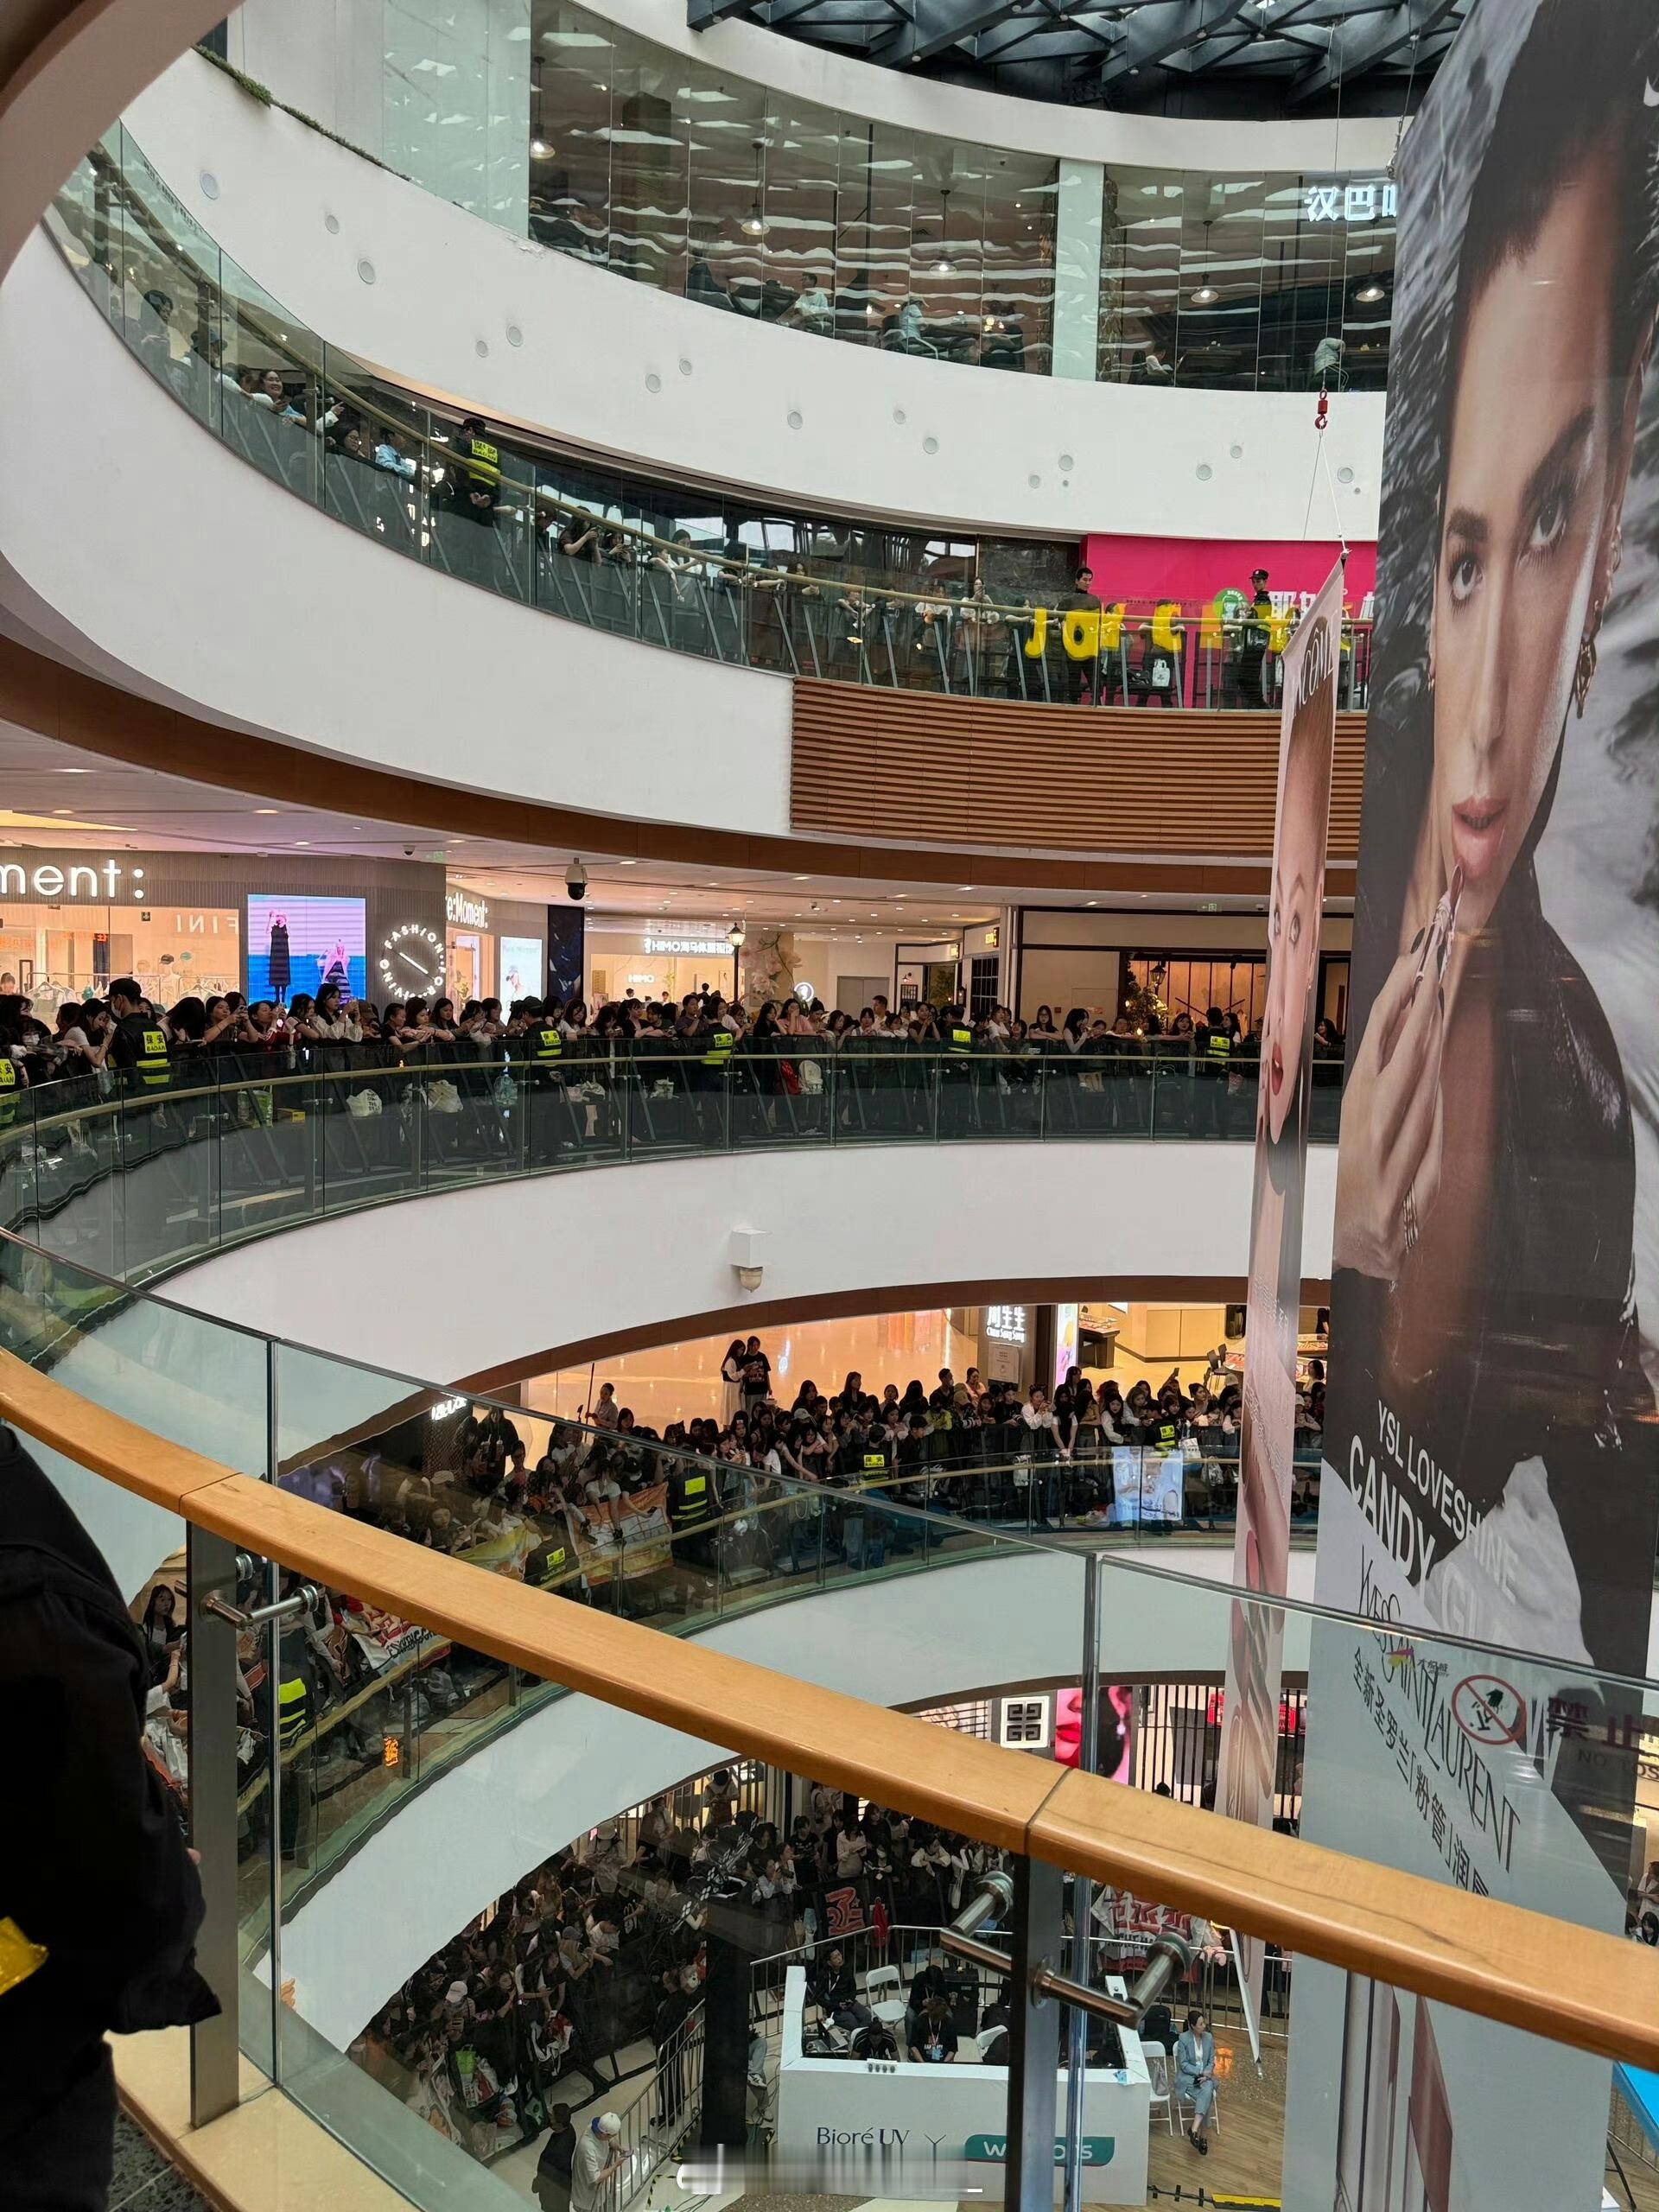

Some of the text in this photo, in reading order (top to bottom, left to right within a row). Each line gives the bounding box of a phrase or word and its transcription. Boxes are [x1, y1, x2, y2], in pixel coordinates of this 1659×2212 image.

[445, 892, 489, 929] e:Moment:
[146, 1034, 165, 1045] 保安
[987, 1306, 1026, 1331] 周生生
[1377, 1399, 1403, 1468] YSL
[1408, 1435, 1517, 1605] LOVESHINE
[1349, 1434, 1436, 1599] CANDY
[1578, 1748, 1608, 1766] NO
[817, 2126, 874, 2145] Bioré
[879, 2129, 910, 2146] UV
